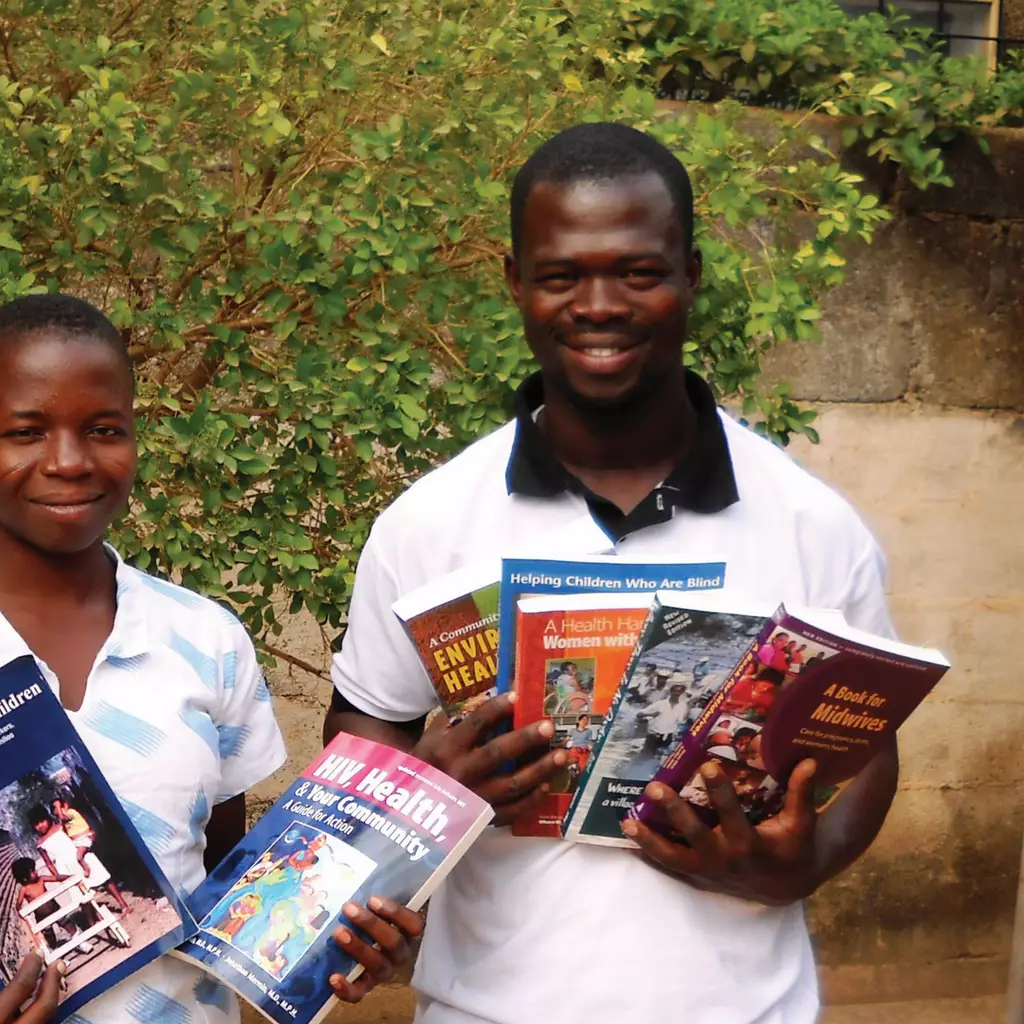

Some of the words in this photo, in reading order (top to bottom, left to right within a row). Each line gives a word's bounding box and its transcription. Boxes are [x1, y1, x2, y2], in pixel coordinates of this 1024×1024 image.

[510, 573, 562, 588] Helping
[565, 576, 621, 588] Children
[625, 578, 657, 589] Who
[660, 578, 683, 589] Are
[687, 576, 720, 588] Blind
[429, 638, 439, 648] A
[439, 613, 500, 643] Communit
[544, 619, 558, 634] A
[561, 618, 613, 632] Health
[543, 635, 602, 650] Women
[734, 651, 754, 677] Book
[724, 678, 735, 694] for
[823, 683, 837, 697] A
[834, 686, 869, 704] Book
[865, 693, 887, 708] for
[691, 693, 725, 737] Midwives
[810, 702, 888, 732] Midwives
[313, 753, 367, 789] HIV,
[356, 768, 449, 843] Health,
[601, 799, 609, 807] a
[282, 799, 294, 811] A
[290, 801, 315, 819] Guide
[312, 809, 327, 822] for
[325, 813, 355, 836] Action
[295, 781, 311, 797] &
[307, 783, 340, 807] Your
[337, 795, 430, 862] Community
[224, 956, 248, 977] Jonathan
[267, 989, 280, 1005] M.D.,
[280, 1000, 298, 1018] M.P.H.
